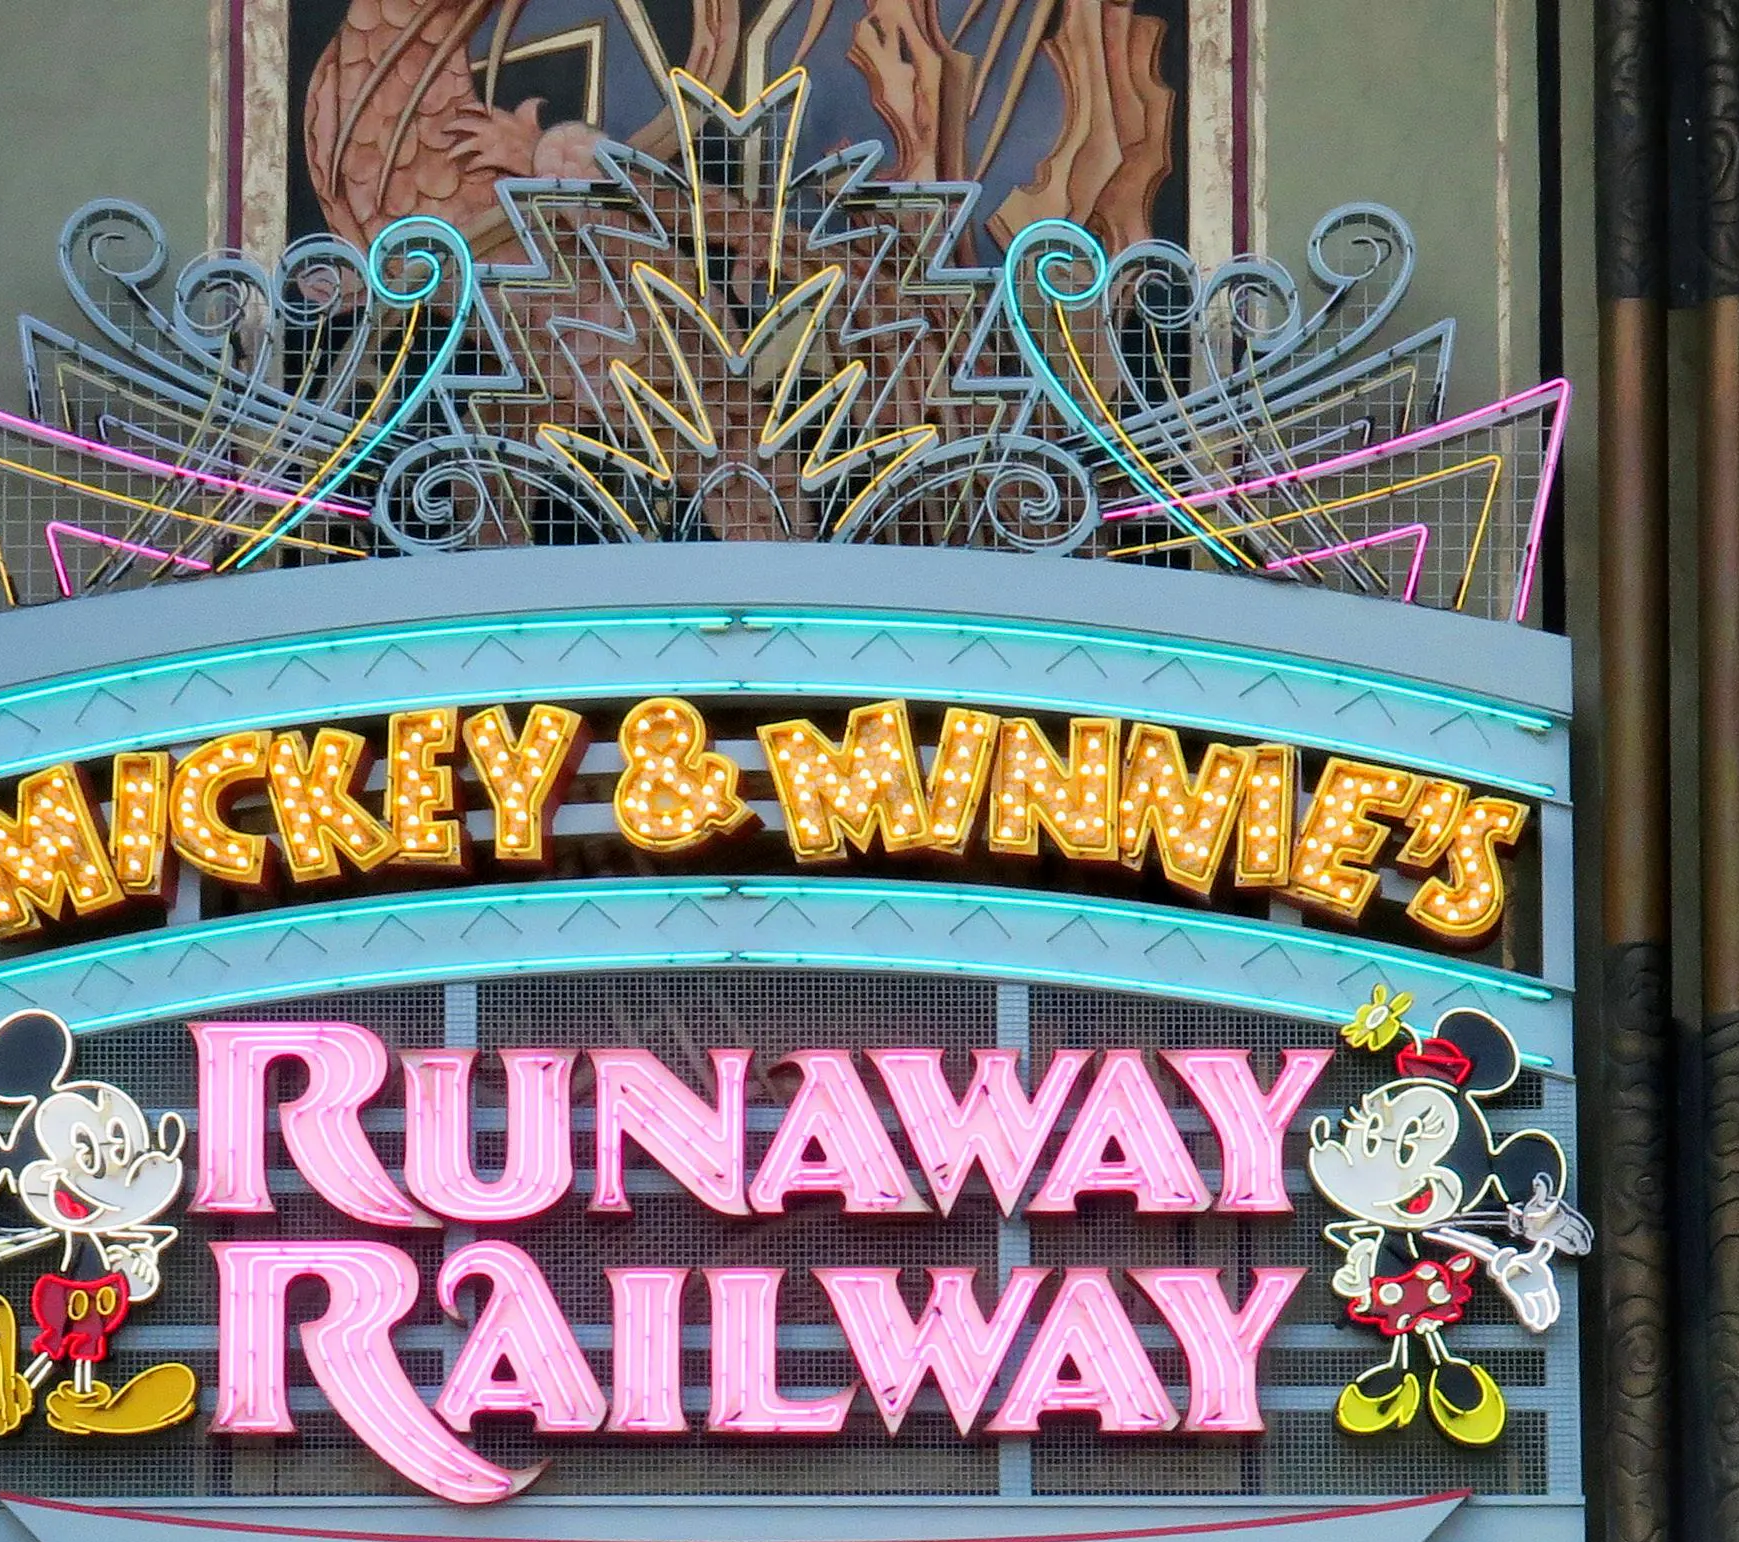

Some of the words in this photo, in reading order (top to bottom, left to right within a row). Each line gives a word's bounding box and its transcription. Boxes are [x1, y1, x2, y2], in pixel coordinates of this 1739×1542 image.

[614, 697, 760, 850] &
[757, 699, 1532, 938] MINNIE'S
[186, 1020, 1335, 1228] RUNAWAY
[209, 1240, 1307, 1504] RAILWAY
